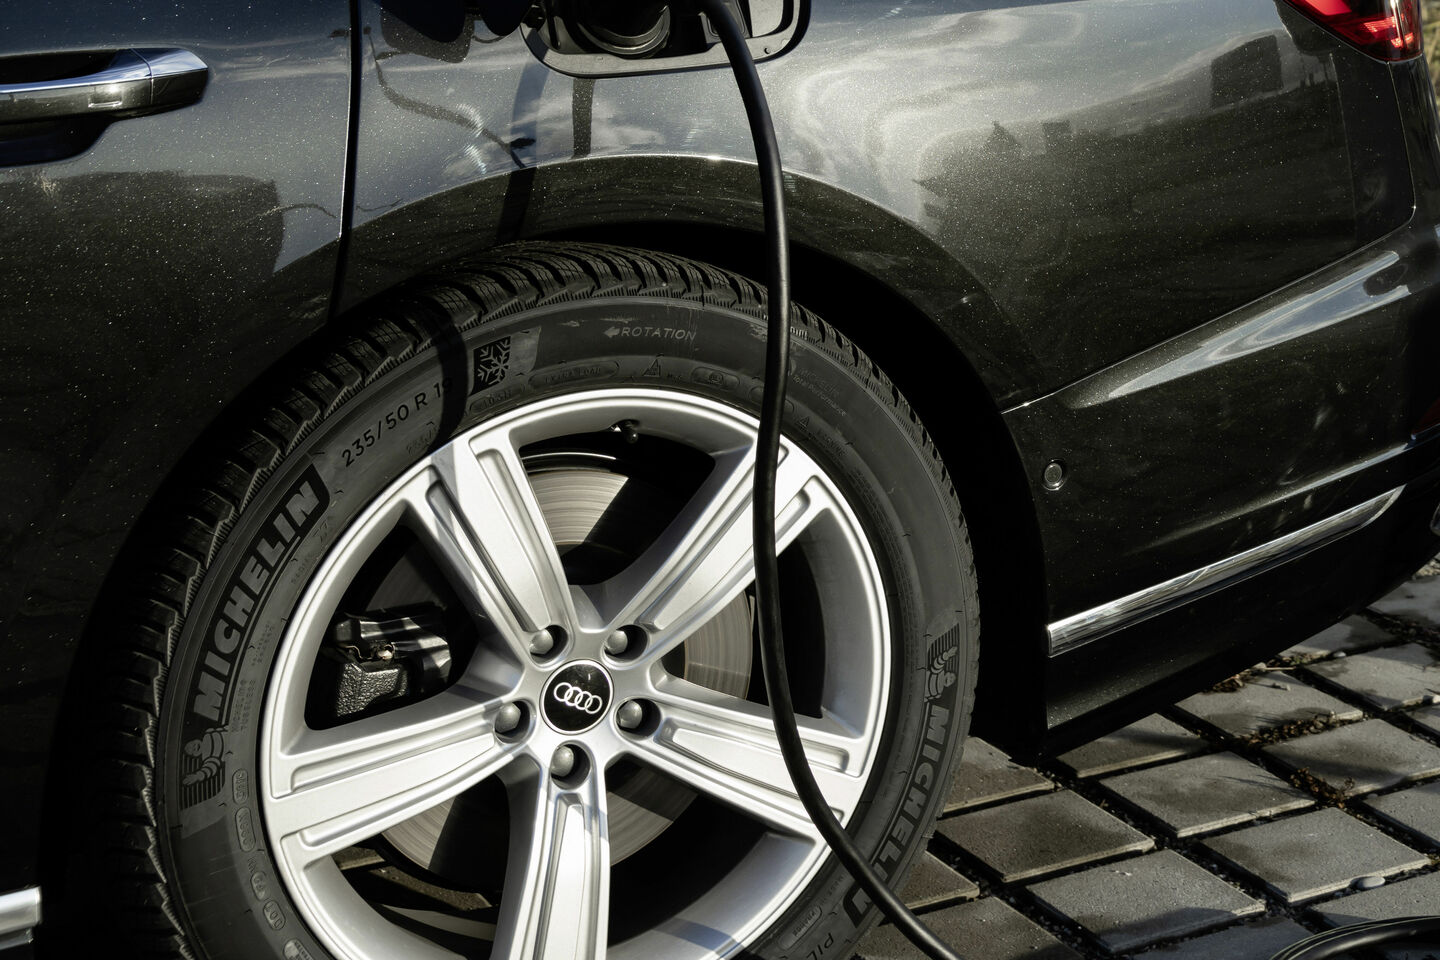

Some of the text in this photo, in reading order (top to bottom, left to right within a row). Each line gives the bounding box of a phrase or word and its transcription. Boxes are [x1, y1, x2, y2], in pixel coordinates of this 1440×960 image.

[620, 326, 697, 341] ROTATION
[341, 404, 410, 466] 235/50
[414, 392, 428, 411] R
[193, 481, 320, 722] MICHELIN
